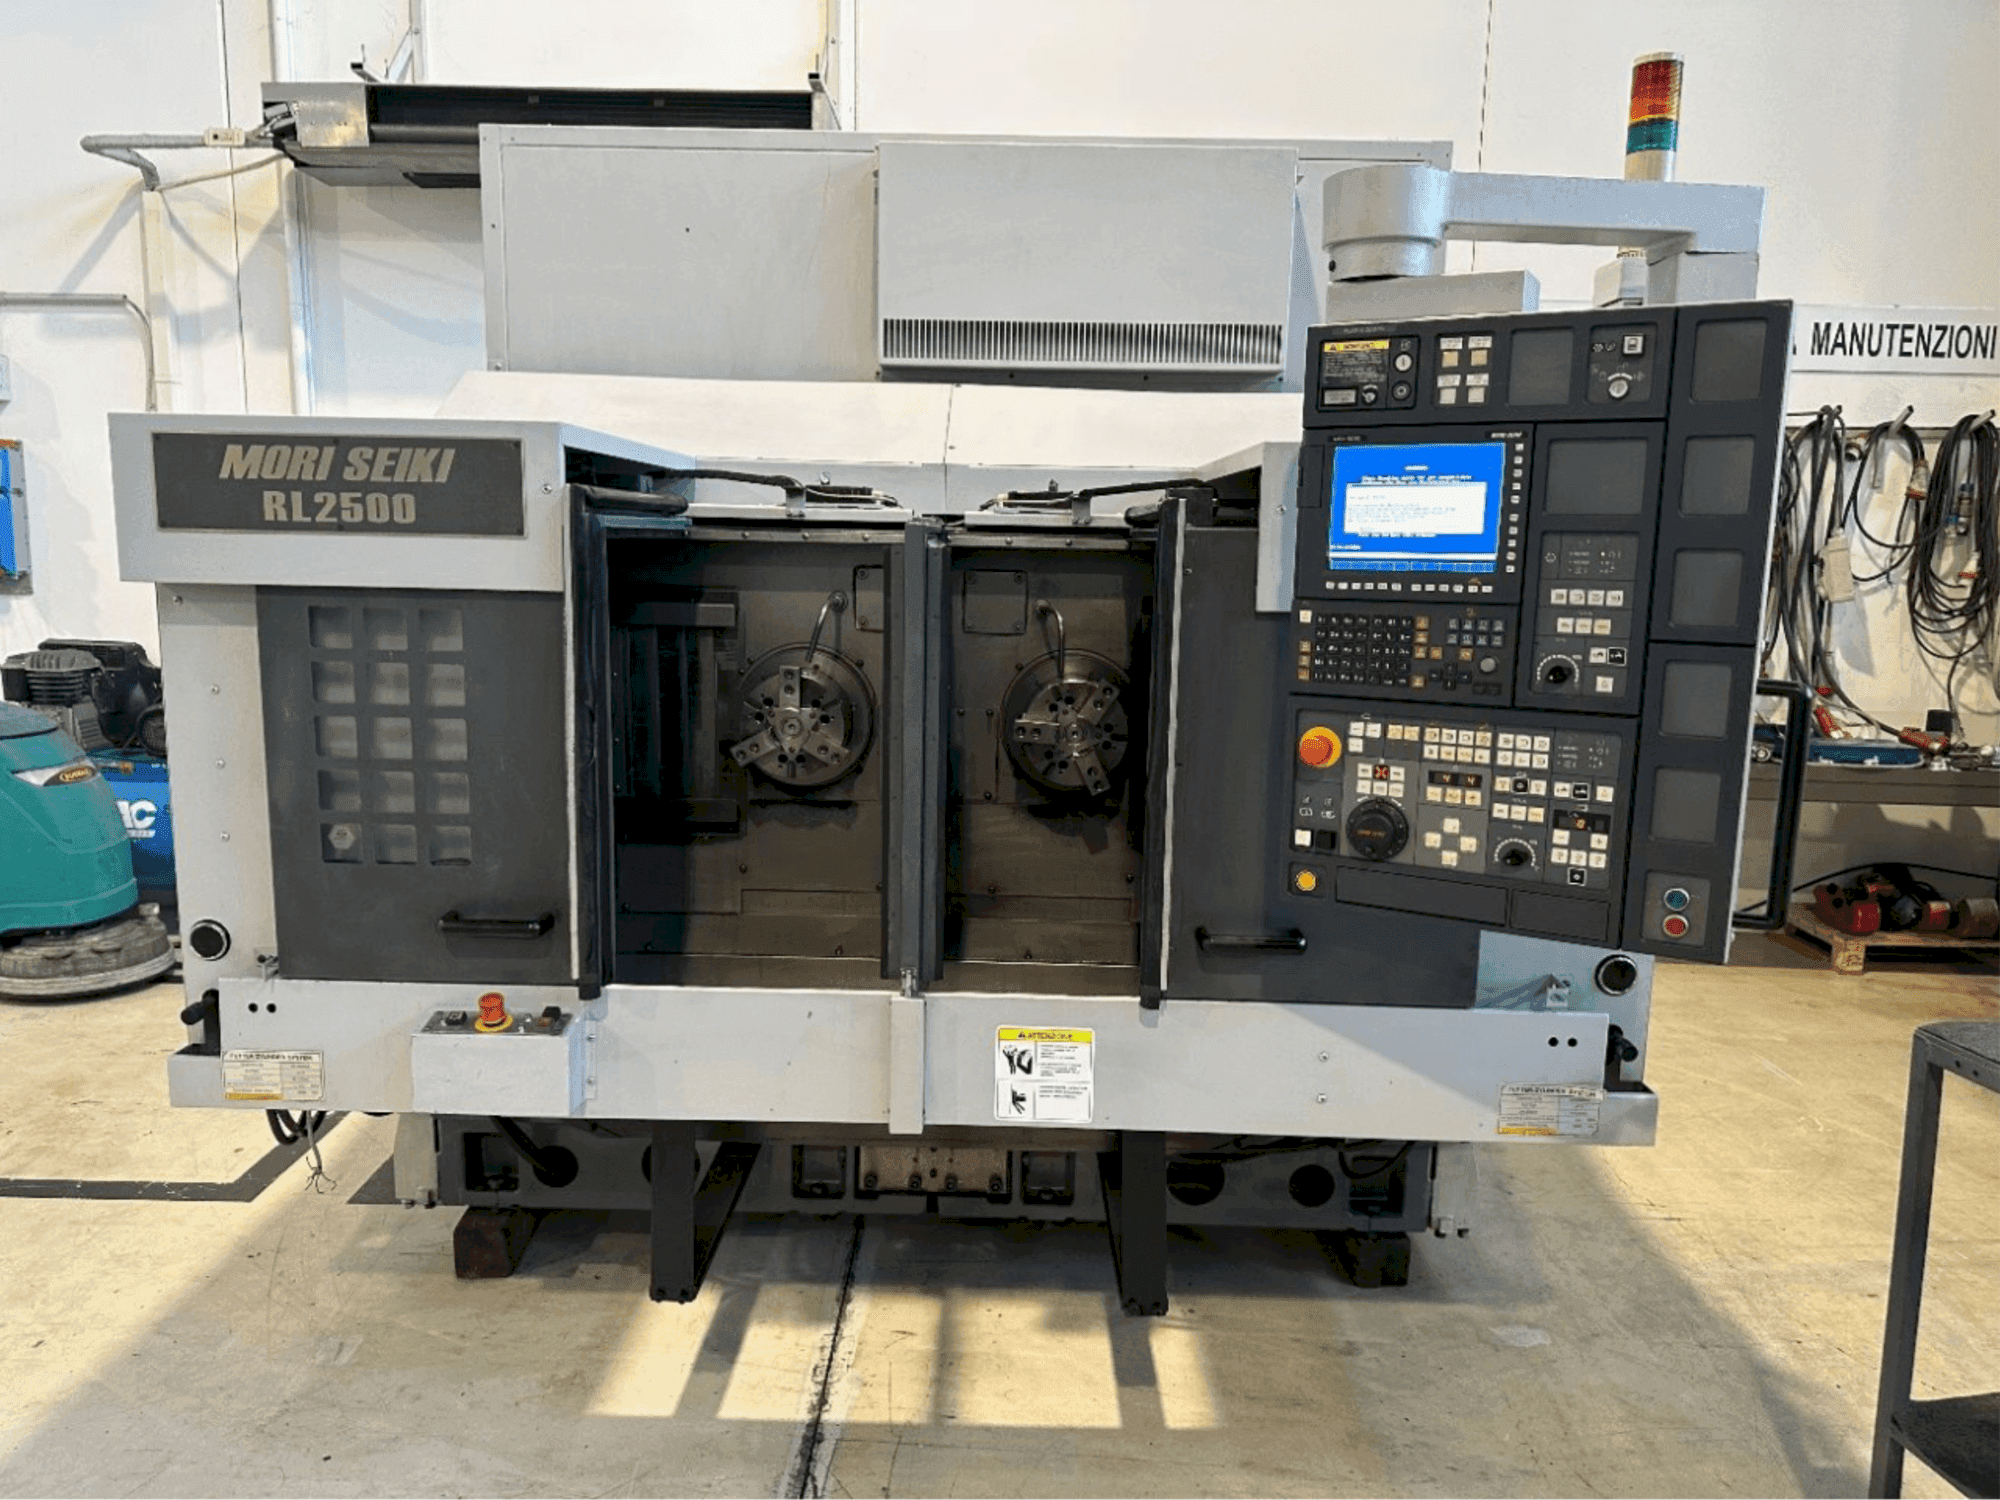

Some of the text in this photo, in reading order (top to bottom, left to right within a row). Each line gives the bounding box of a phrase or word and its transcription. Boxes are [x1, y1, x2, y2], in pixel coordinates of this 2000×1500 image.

[1811, 322, 1998, 359] MANUTENZIONI
[219, 444, 456, 483] MORI SEIKI
[263, 490, 416, 524] RL2500
